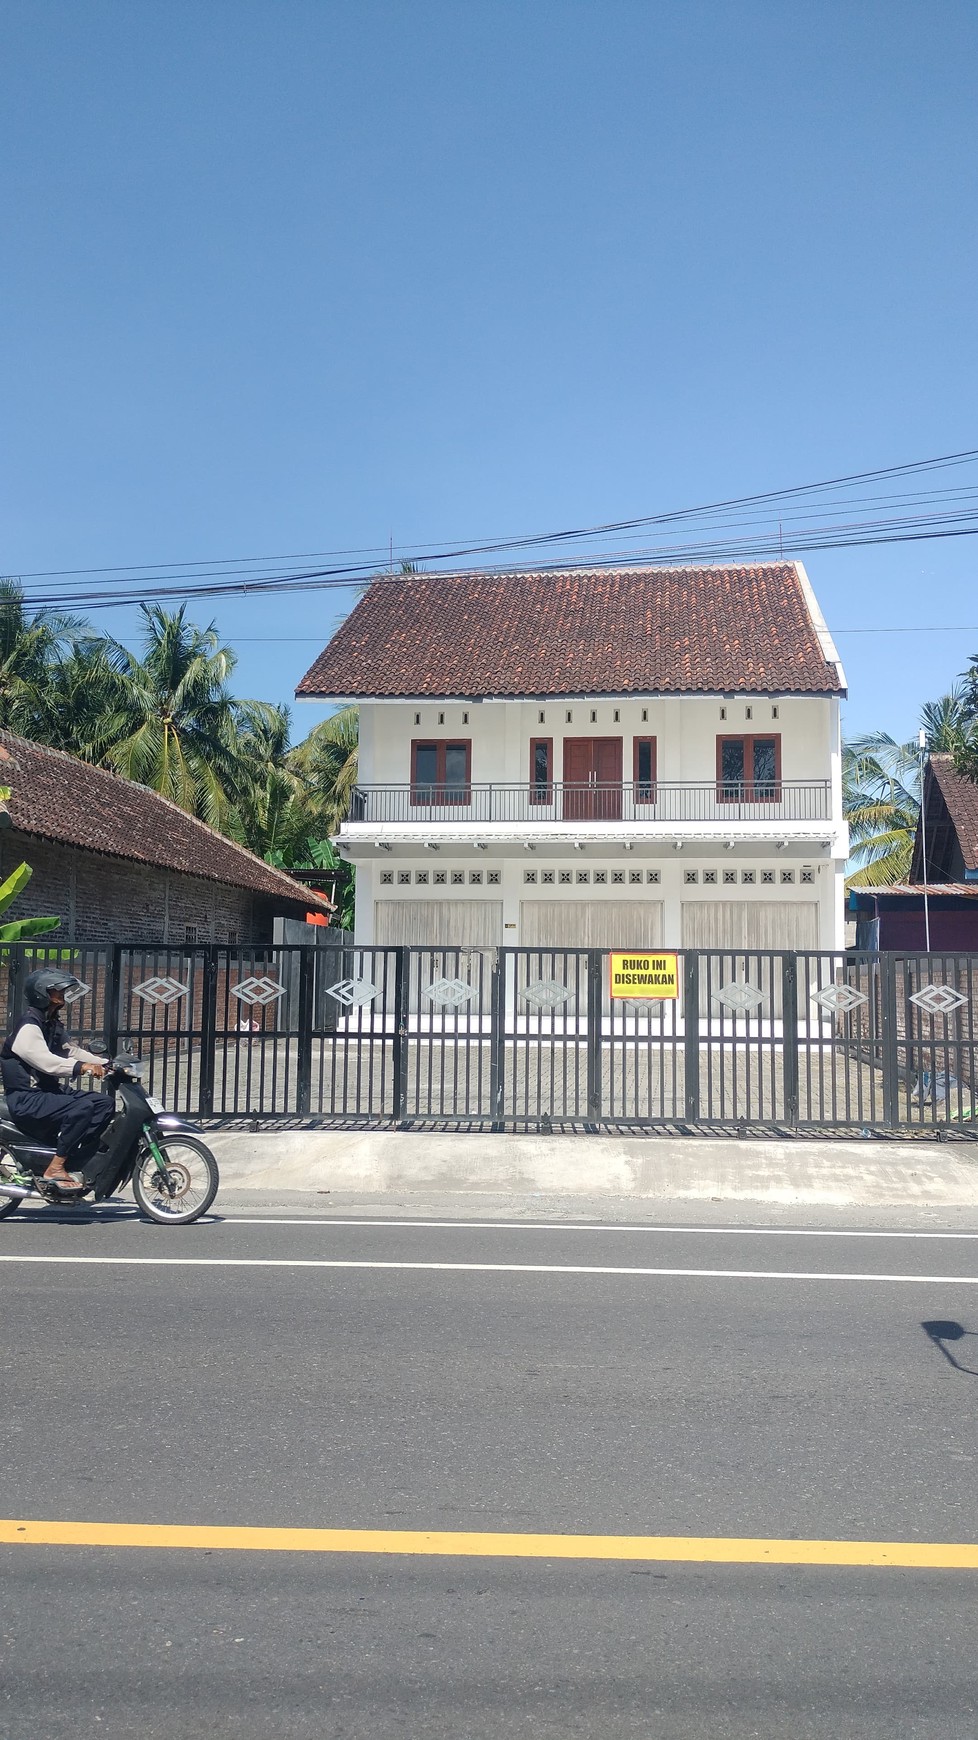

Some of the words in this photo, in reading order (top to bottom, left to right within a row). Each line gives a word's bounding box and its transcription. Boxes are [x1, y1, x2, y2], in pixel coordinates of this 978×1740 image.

[622, 959, 650, 970] RUKO
[652, 959, 667, 970] INI
[614, 973, 675, 985] DISEWAKAN
